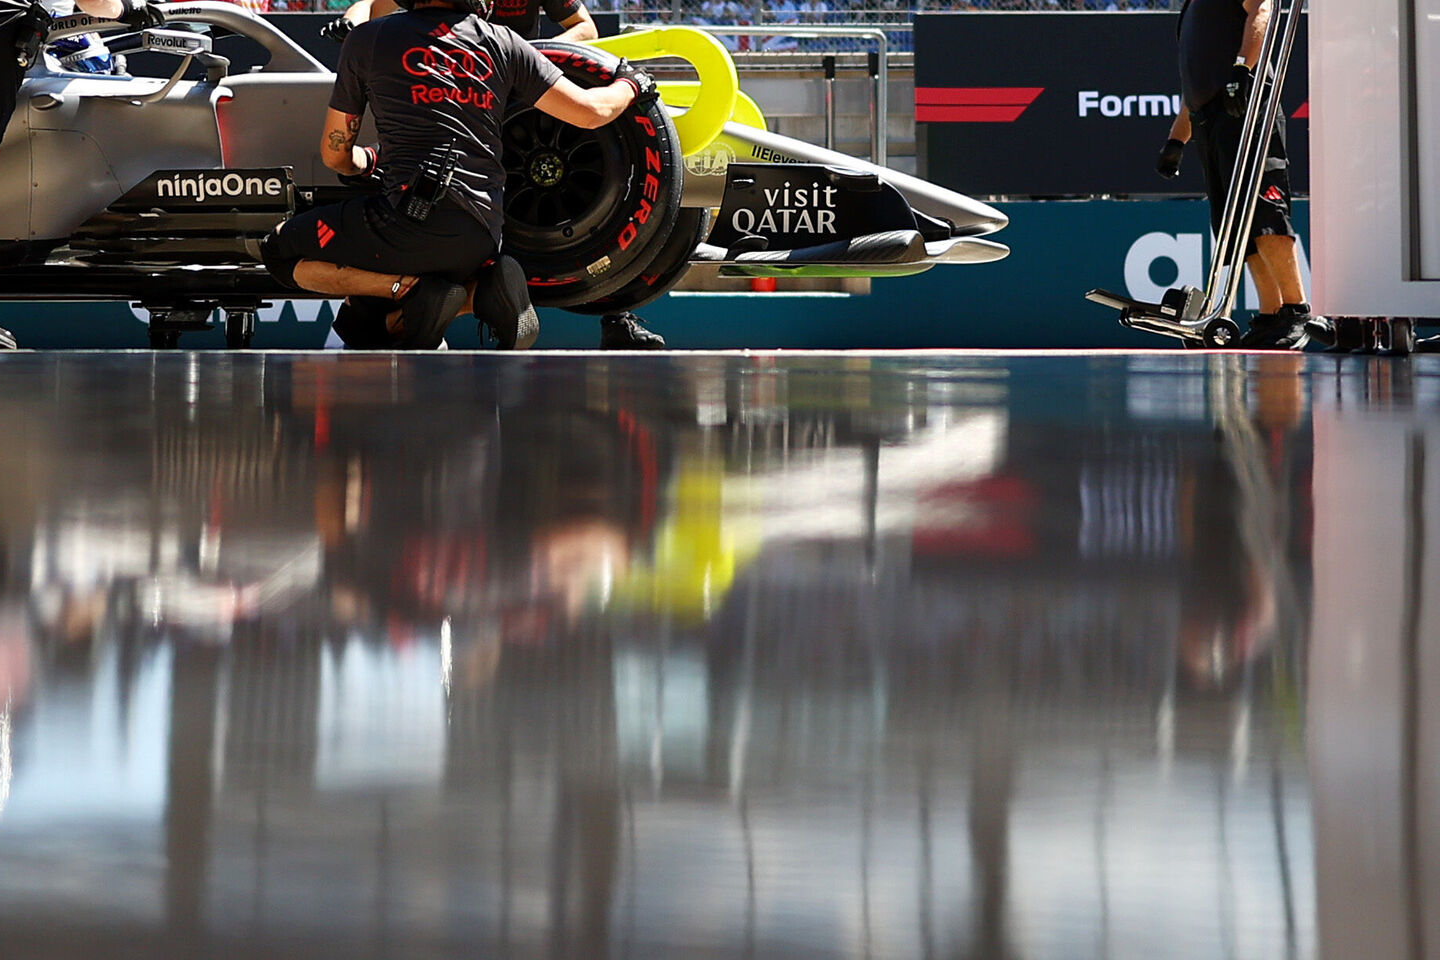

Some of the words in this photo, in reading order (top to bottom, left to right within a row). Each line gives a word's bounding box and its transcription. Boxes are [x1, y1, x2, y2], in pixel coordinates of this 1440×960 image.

[50, 19, 78, 32] ORLD
[147, 34, 187, 48] Revolut
[157, 173, 282, 202] ninjaOne
[617, 146, 662, 252] ZERO
[763, 181, 838, 208] visit
[732, 208, 838, 237] QATAR
